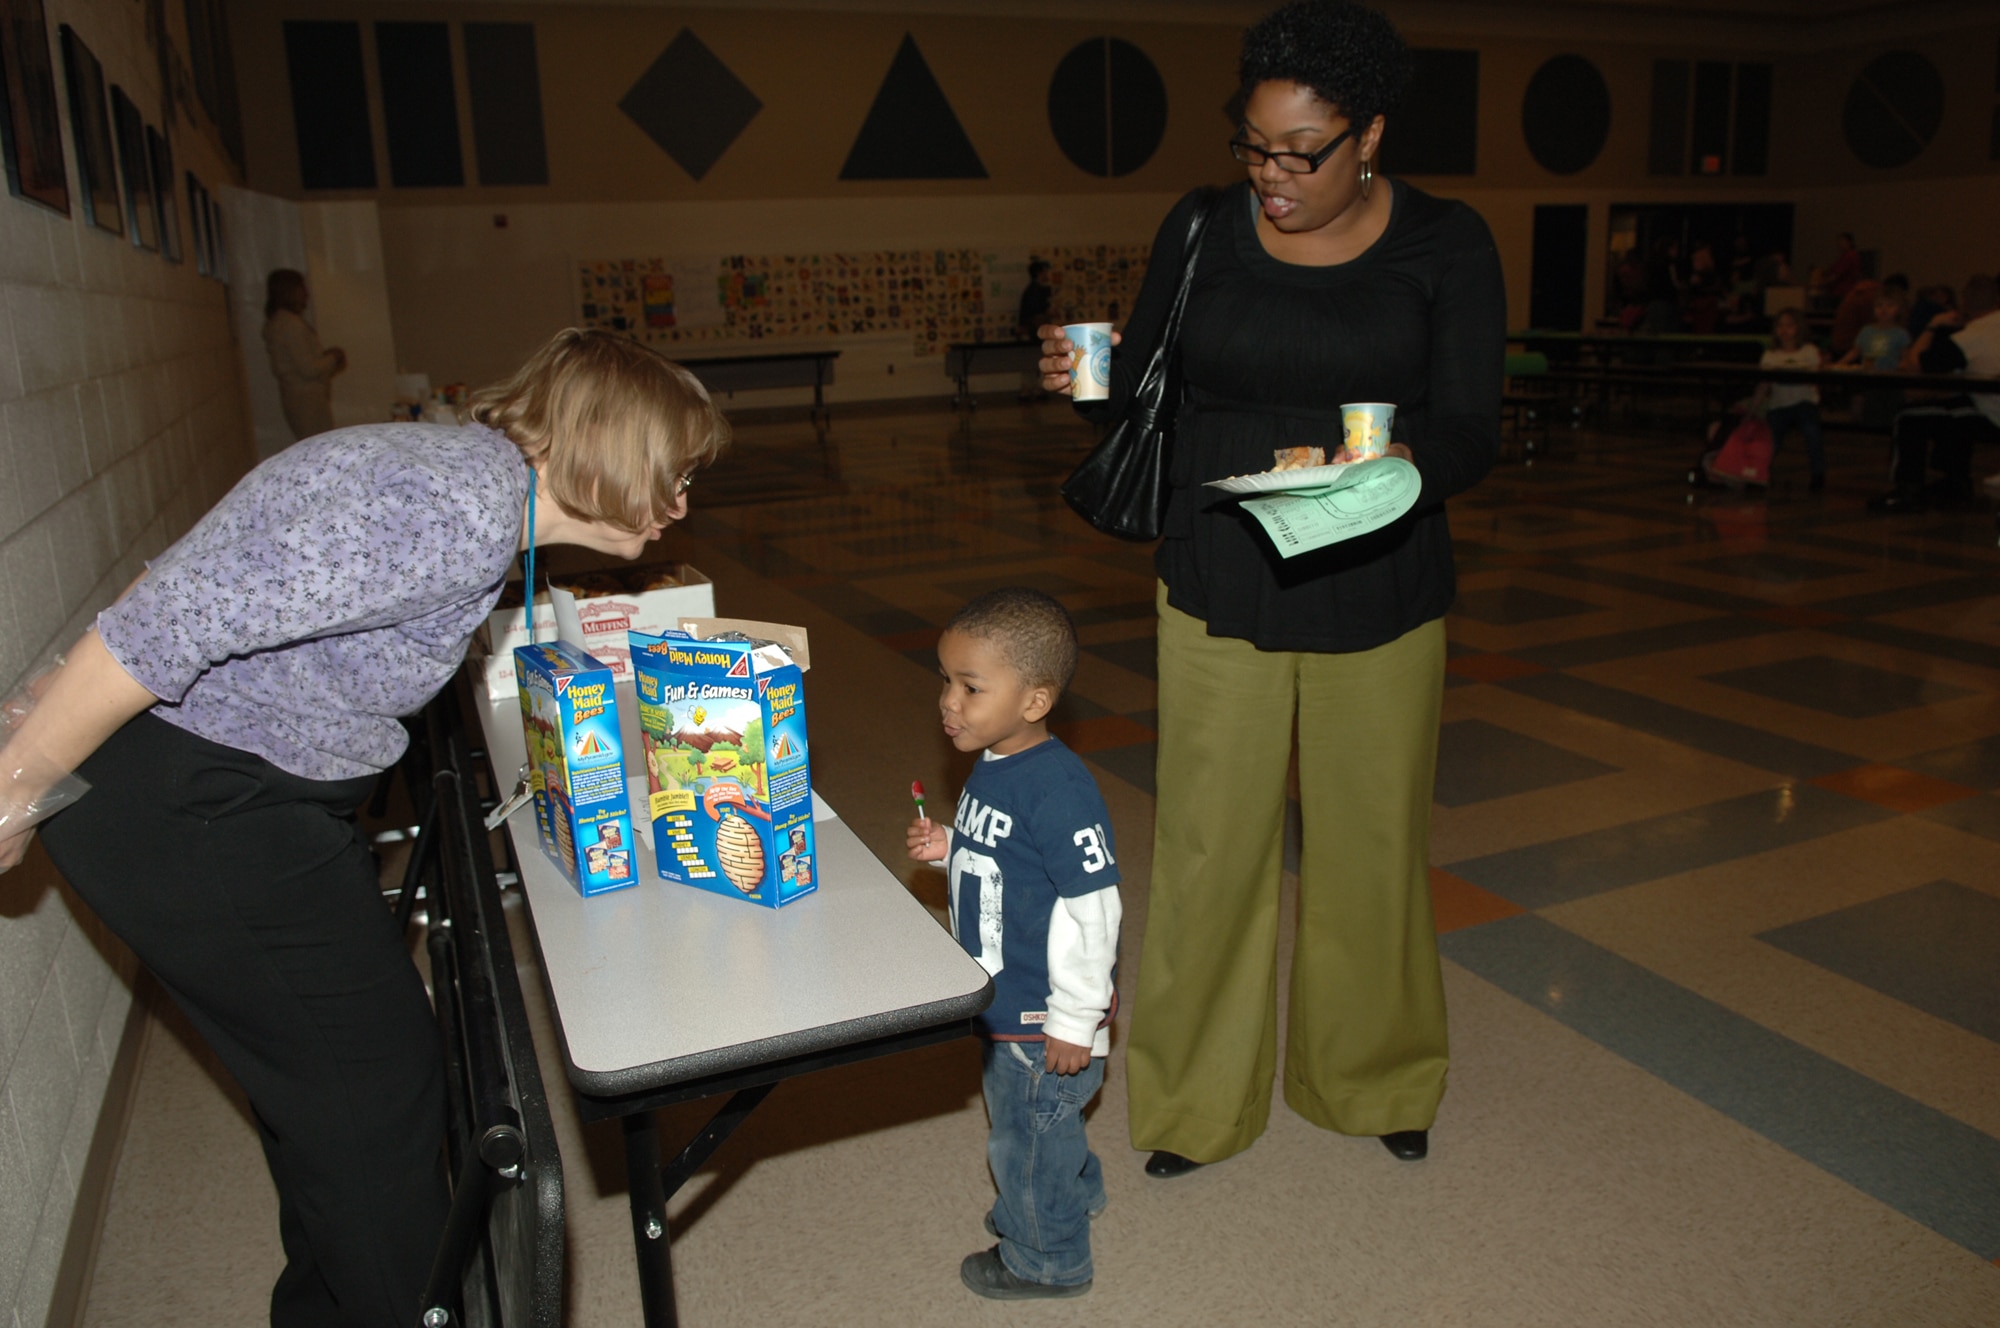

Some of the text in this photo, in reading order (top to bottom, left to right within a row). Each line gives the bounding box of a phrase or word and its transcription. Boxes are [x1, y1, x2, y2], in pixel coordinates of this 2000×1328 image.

[647, 640, 668, 655] Bees
[669, 650, 731, 669] Honey Maid
[567, 683, 605, 699] Honey
[664, 681, 753, 704] Fun & Games!
[766, 683, 796, 701] Honey
[572, 694, 603, 710] Maid
[771, 695, 794, 712] Maid
[573, 706, 604, 725] Bees
[771, 707, 795, 728] Bees
[954, 787, 1013, 848] AMP
